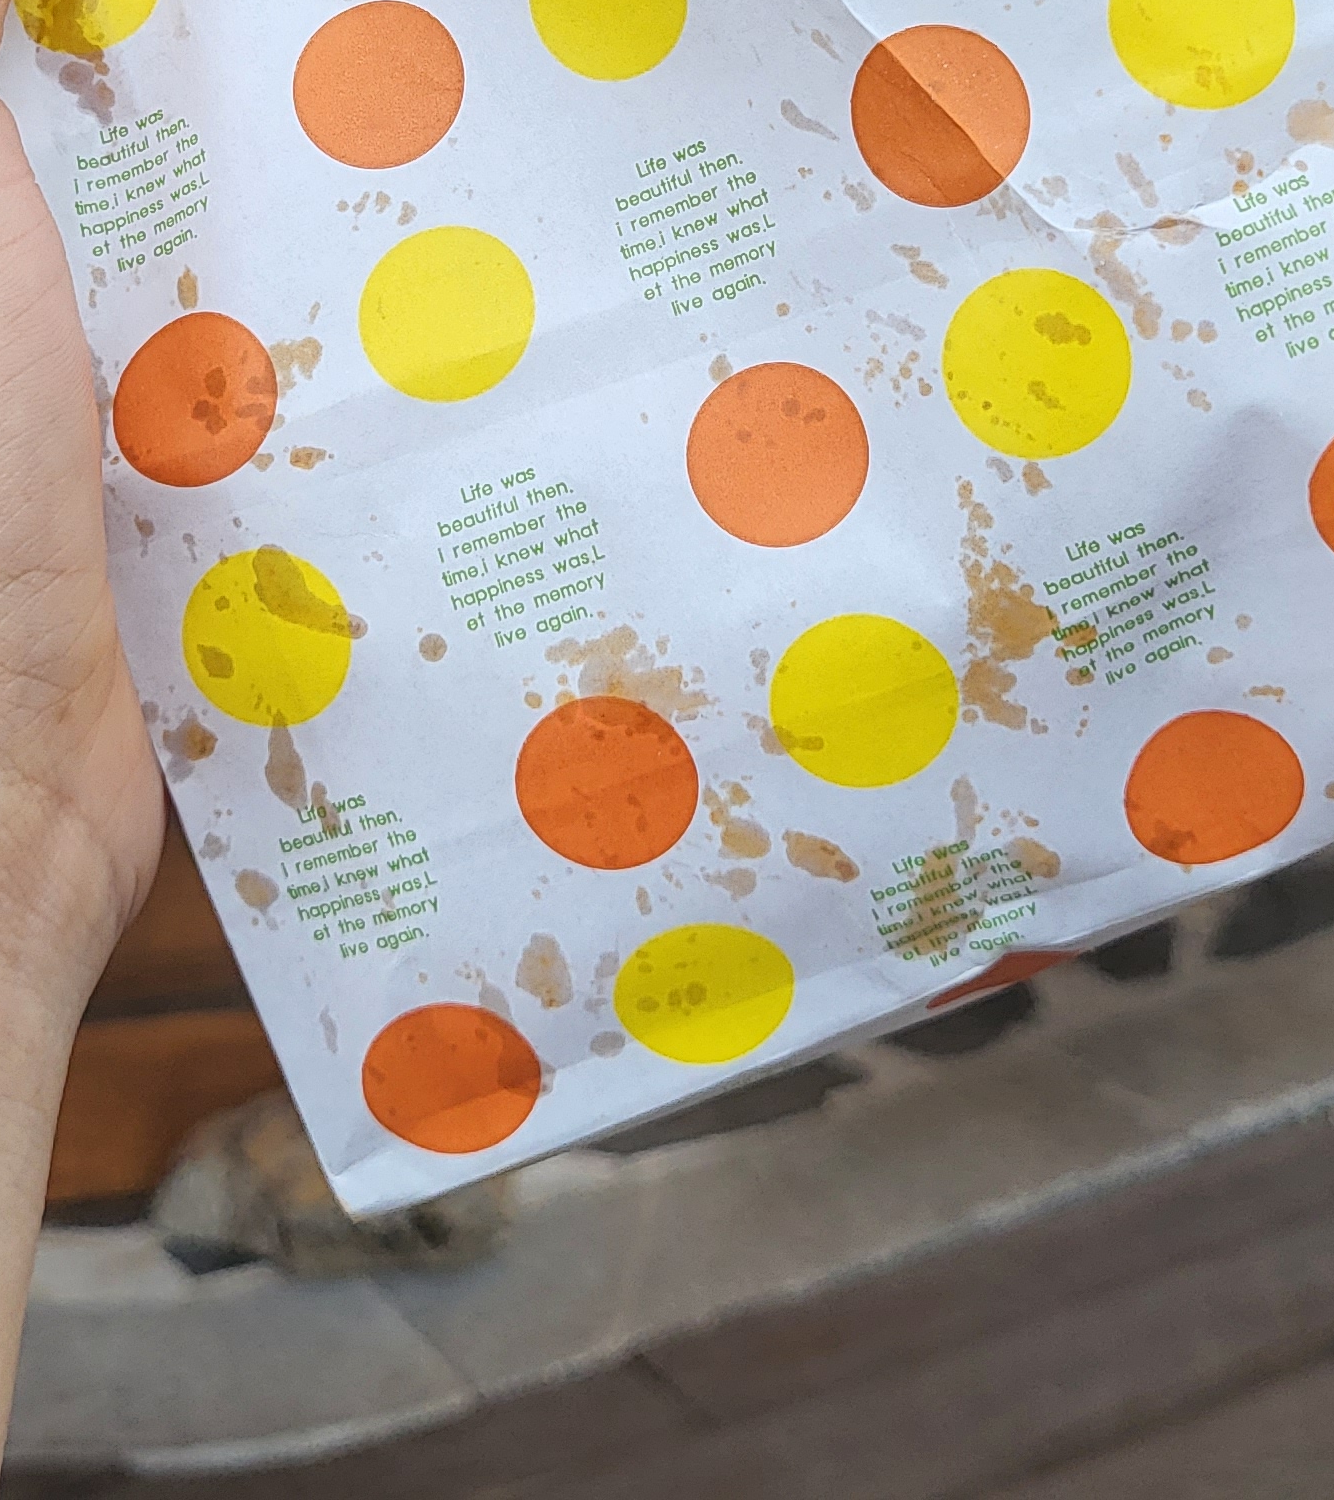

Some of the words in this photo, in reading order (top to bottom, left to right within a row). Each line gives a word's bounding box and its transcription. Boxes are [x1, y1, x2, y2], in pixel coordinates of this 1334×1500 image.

[614, 168, 693, 212] beautiful
[698, 153, 744, 178] then.
[635, 157, 667, 179] Life
[672, 140, 707, 163] was
[630, 185, 718, 232] remember
[726, 171, 757, 192] the
[670, 212, 718, 241] knew
[726, 187, 769, 218] what
[1232, 192, 1268, 213] Life
[1271, 174, 1310, 197] was
[1214, 202, 1299, 248] beautiful
[1233, 220, 1327, 269] remember
[628, 238, 720, 282] happiness
[643, 281, 663, 301] et
[671, 271, 702, 291] the
[708, 240, 775, 278] memory
[1277, 247, 1329, 278] knew
[670, 296, 703, 317] live
[711, 273, 767, 301] again.
[1235, 275, 1333, 323] happiness
[1255, 322, 1275, 343] et
[1283, 310, 1316, 332] the
[1285, 336, 1320, 359] live
[460, 482, 493, 504] Life
[500, 467, 536, 490] was
[436, 495, 520, 538] beautiful
[525, 481, 574, 506] then.
[452, 514, 546, 559] remember
[555, 501, 587, 522] the
[494, 541, 544, 569] knew
[553, 518, 599, 548] what
[450, 568, 545, 611] happiness
[466, 611, 486, 631] et
[494, 602, 525, 622] the
[533, 572, 604, 609] memory
[493, 627, 527, 649] live
[536, 605, 594, 633] again.
[294, 839, 378, 874] remember
[386, 829, 417, 848] the
[313, 923, 331, 941] et
[337, 918, 366, 935] the
[372, 895, 438, 926] memory
